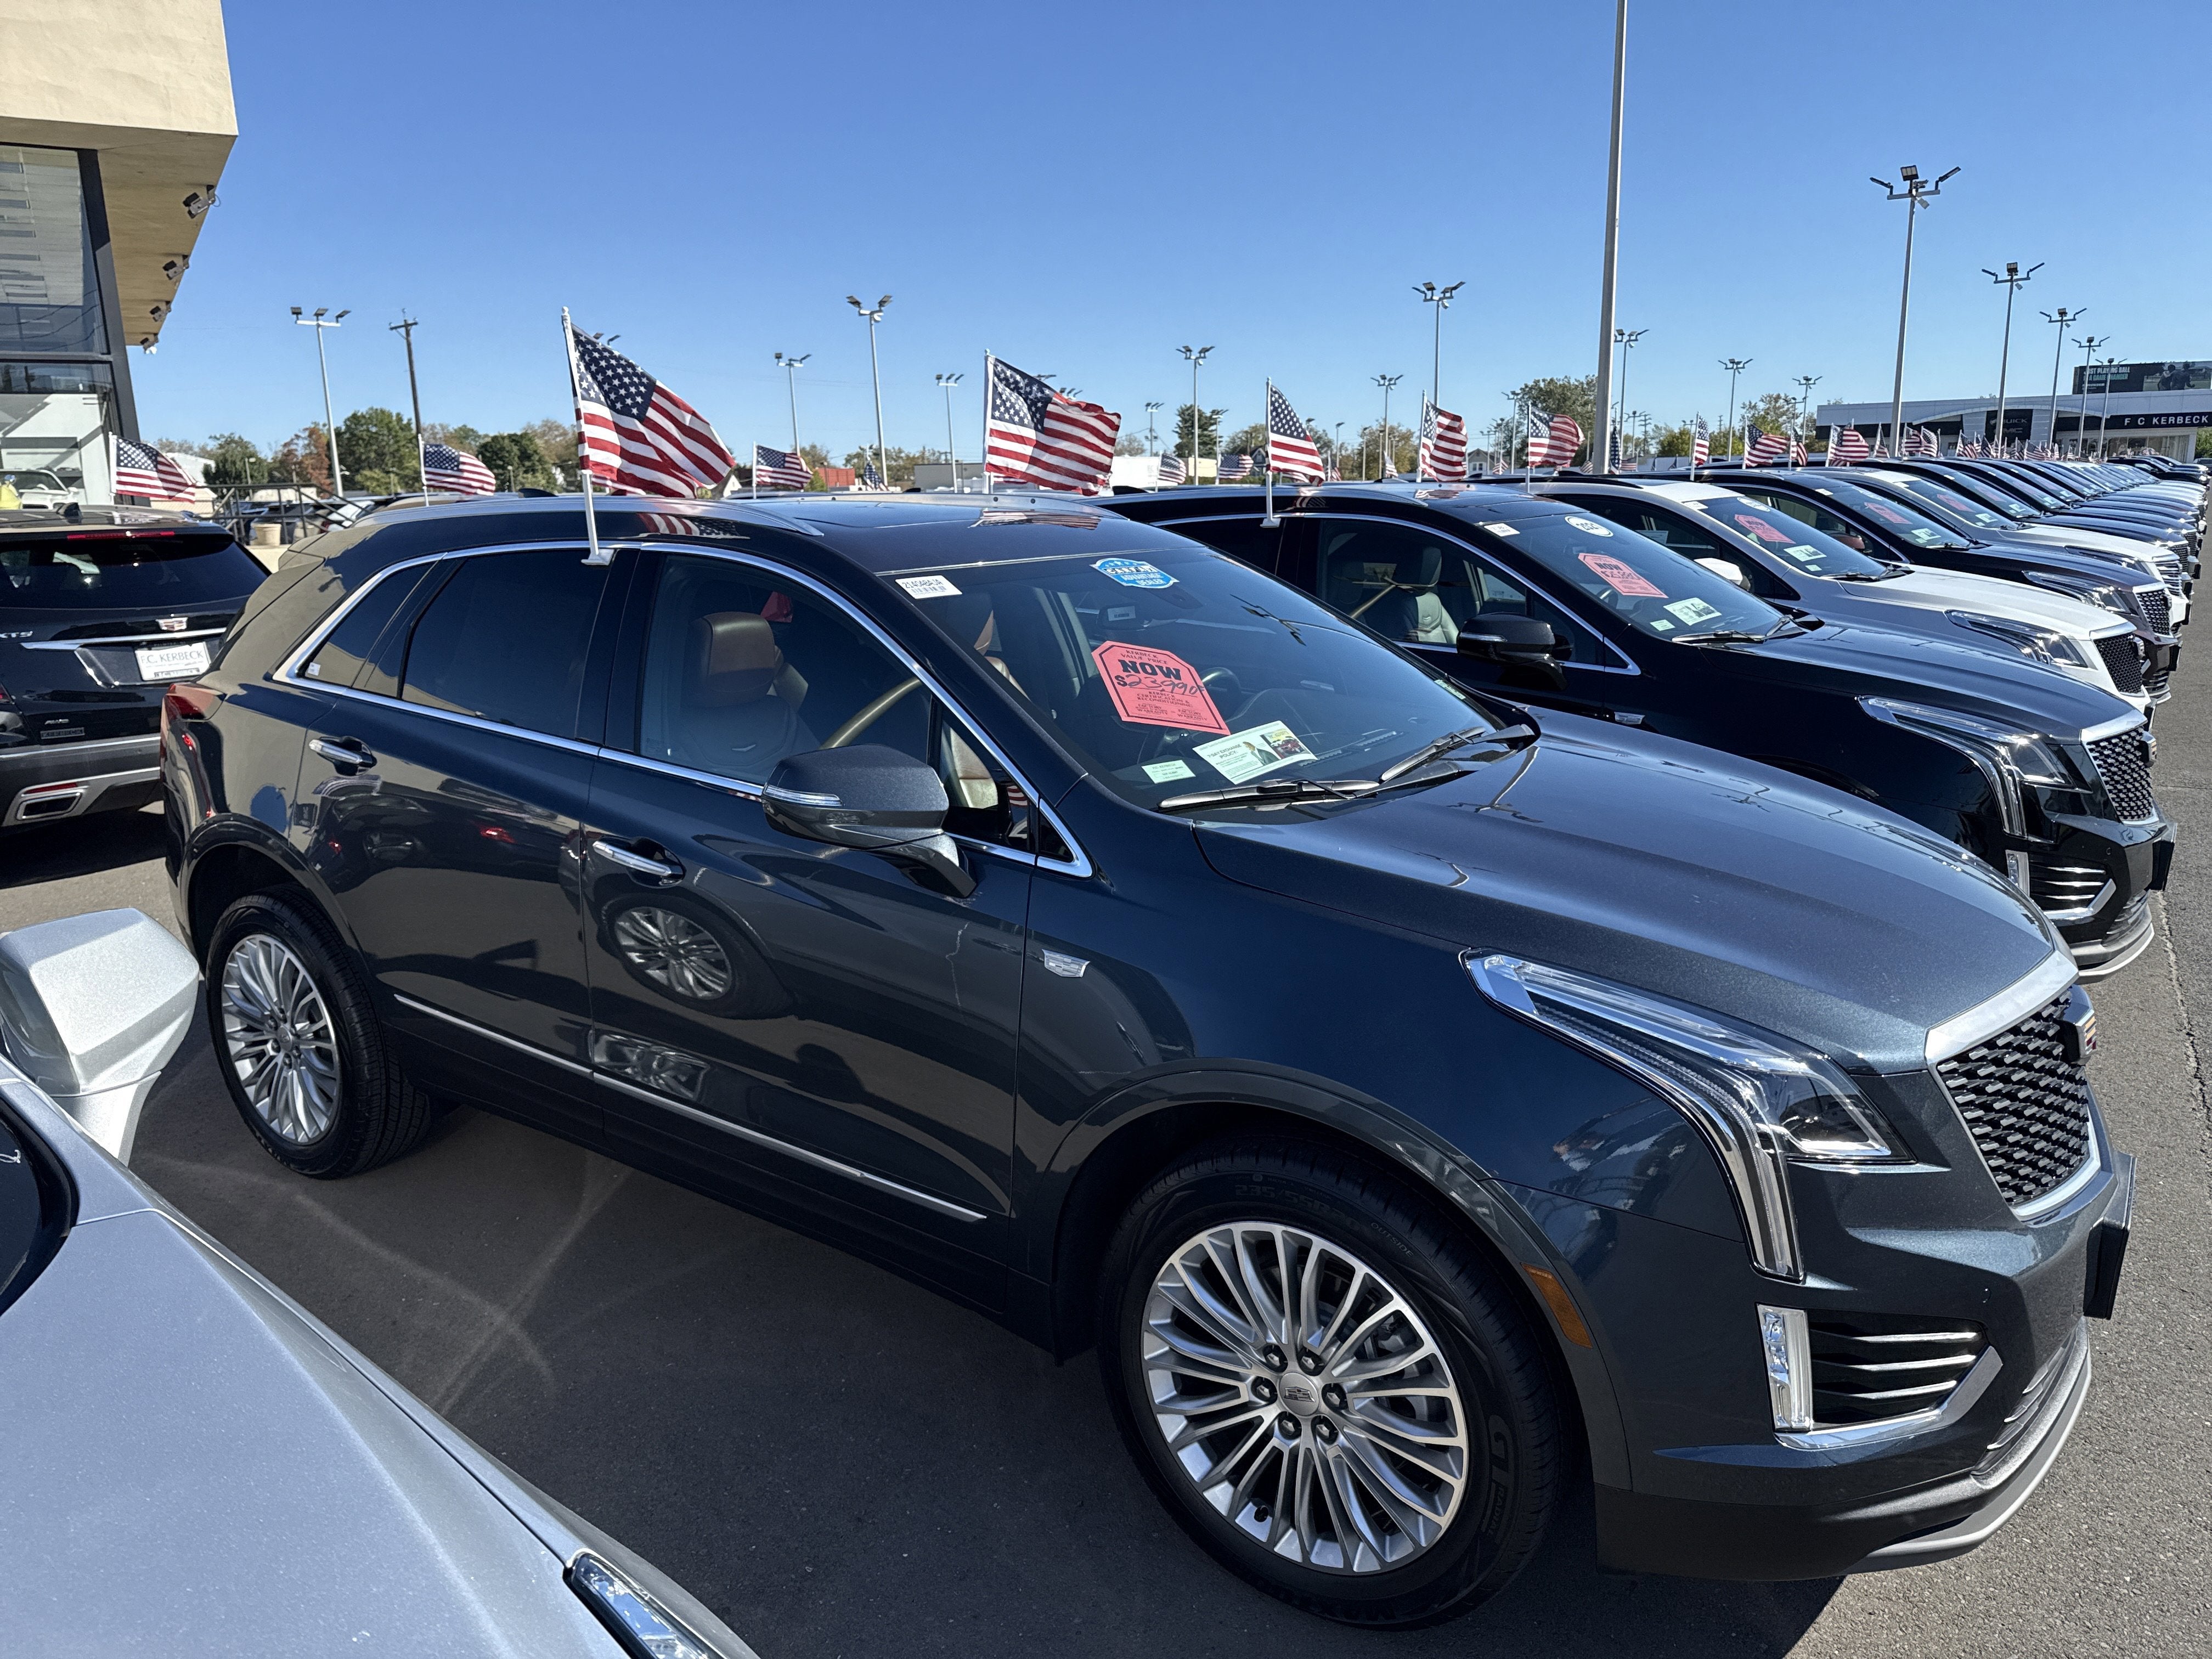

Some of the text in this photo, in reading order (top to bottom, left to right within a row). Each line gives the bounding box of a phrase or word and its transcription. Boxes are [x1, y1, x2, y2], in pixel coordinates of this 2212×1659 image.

[2124, 415, 2209, 426] F C KERBECK
[160, 650, 204, 663] KERBECK
[1126, 650, 1159, 659] KERBECK
[1118, 659, 1182, 681] NOW
[1137, 693, 1183, 703] CERTIFICATION
[1137, 697, 1193, 708] RECONDITIONING
[1370, 1222, 1414, 1258] OUTSIDE
